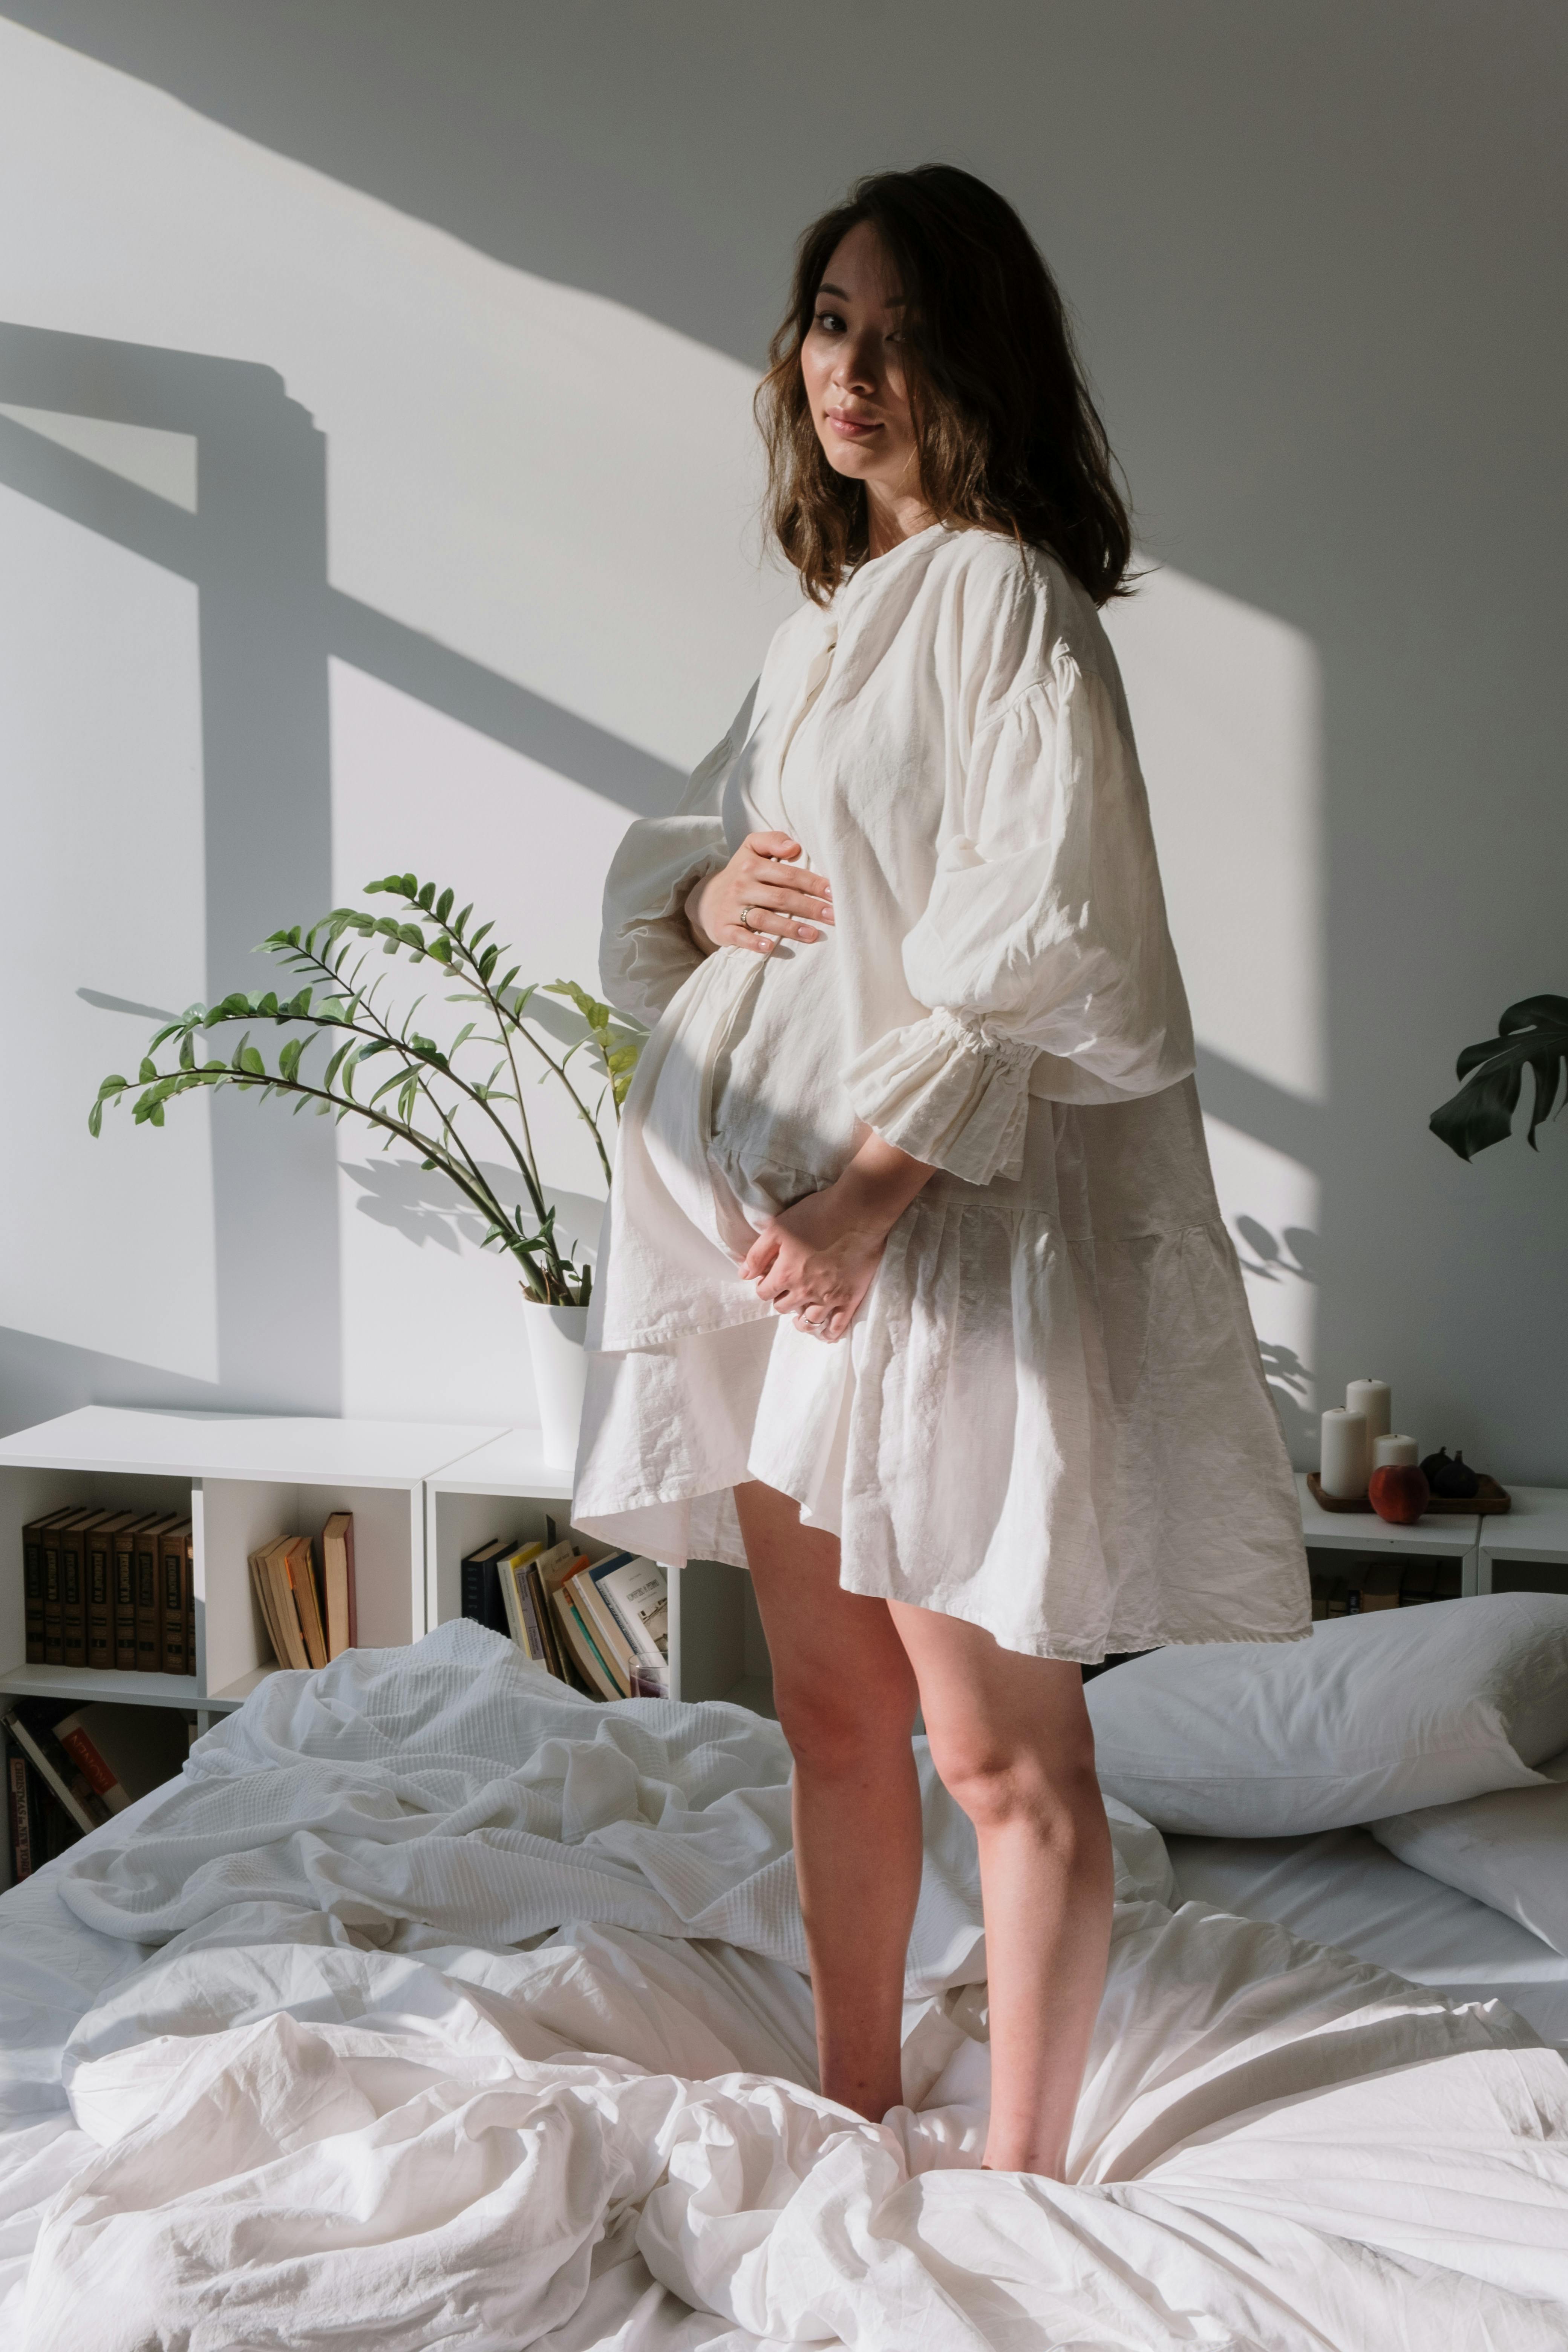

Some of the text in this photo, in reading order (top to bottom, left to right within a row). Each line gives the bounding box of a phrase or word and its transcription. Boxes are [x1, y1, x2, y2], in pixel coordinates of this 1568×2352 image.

[15, 1761, 26, 1816] CHRISTMAS
[19, 1825, 28, 1847] NEW
[20, 1848, 30, 1873] YORK
